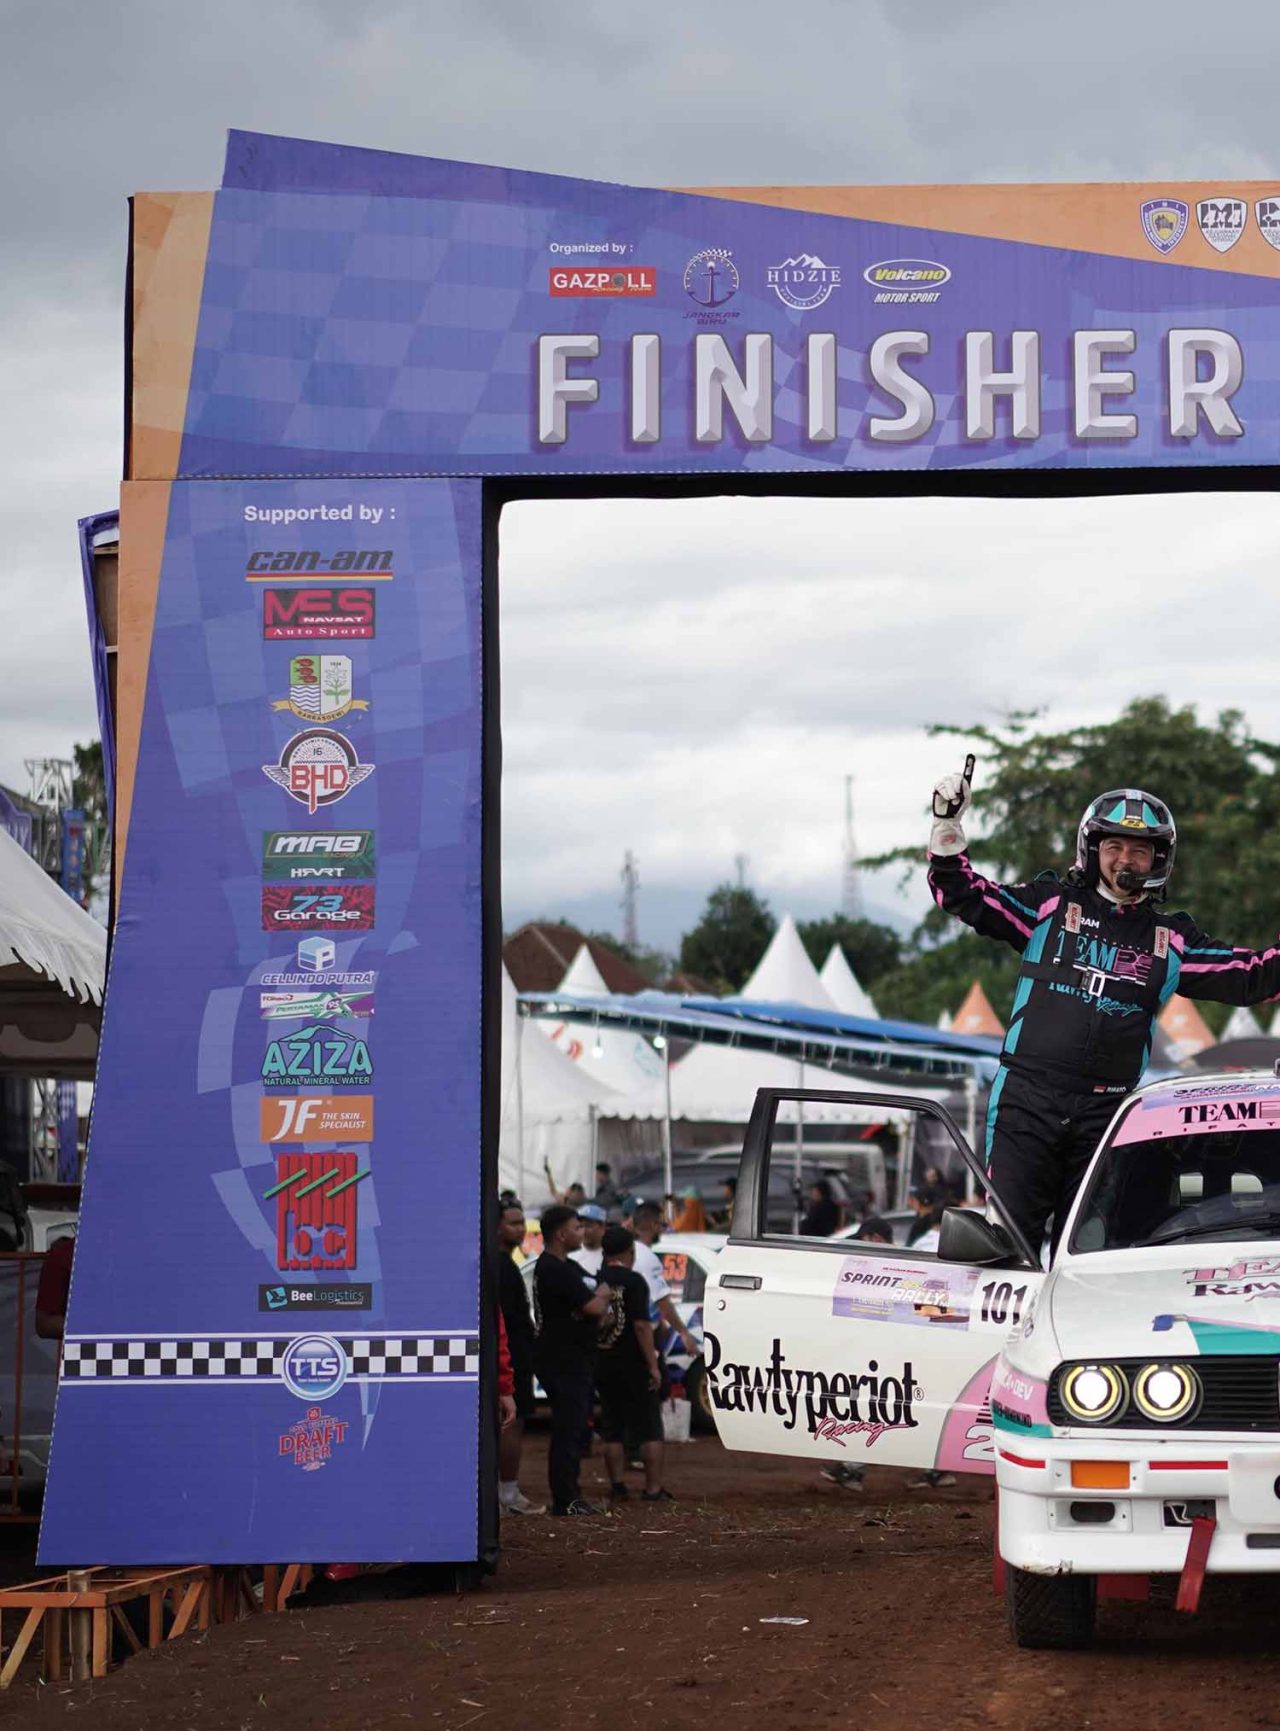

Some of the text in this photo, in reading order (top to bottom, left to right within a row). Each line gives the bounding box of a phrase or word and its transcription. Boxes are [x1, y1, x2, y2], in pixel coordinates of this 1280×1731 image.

[550, 243, 609, 254] Organized
[612, 243, 626, 254] by
[767, 270, 841, 282] HIDZIE
[874, 269, 946, 281] Volcano
[874, 292, 942, 304] MOTOR SPORT
[538, 328, 1245, 445] FINISHER
[244, 504, 353, 524] Supported
[360, 504, 383, 524] by
[246, 550, 393, 571] can-am
[273, 627, 366, 637] Auto Sport
[313, 747, 323, 756] 16
[290, 764, 349, 814] BHD
[274, 836, 362, 853] MAB
[293, 895, 343, 912] 73
[274, 909, 360, 922] Garage
[261, 972, 373, 985] CELLINDO PUTRA
[261, 1040, 374, 1077] AZIZA
[264, 1076, 370, 1086] NATURAL MINERAL WATER
[270, 1100, 323, 1140] JF
[322, 1112, 360, 1120] THE SKIN
[1178, 1102, 1257, 1124] TEAM
[320, 1120, 367, 1129] SPECIALIST
[841, 1271, 902, 1288] SPRINT
[891, 1287, 946, 1306] RALLY
[981, 1281, 1028, 1326] 101
[291, 1358, 338, 1376] TTS
[279, 1422, 350, 1455] DRAFT
[813, 1416, 912, 1447] Racing
[294, 1445, 332, 1465] BEER
